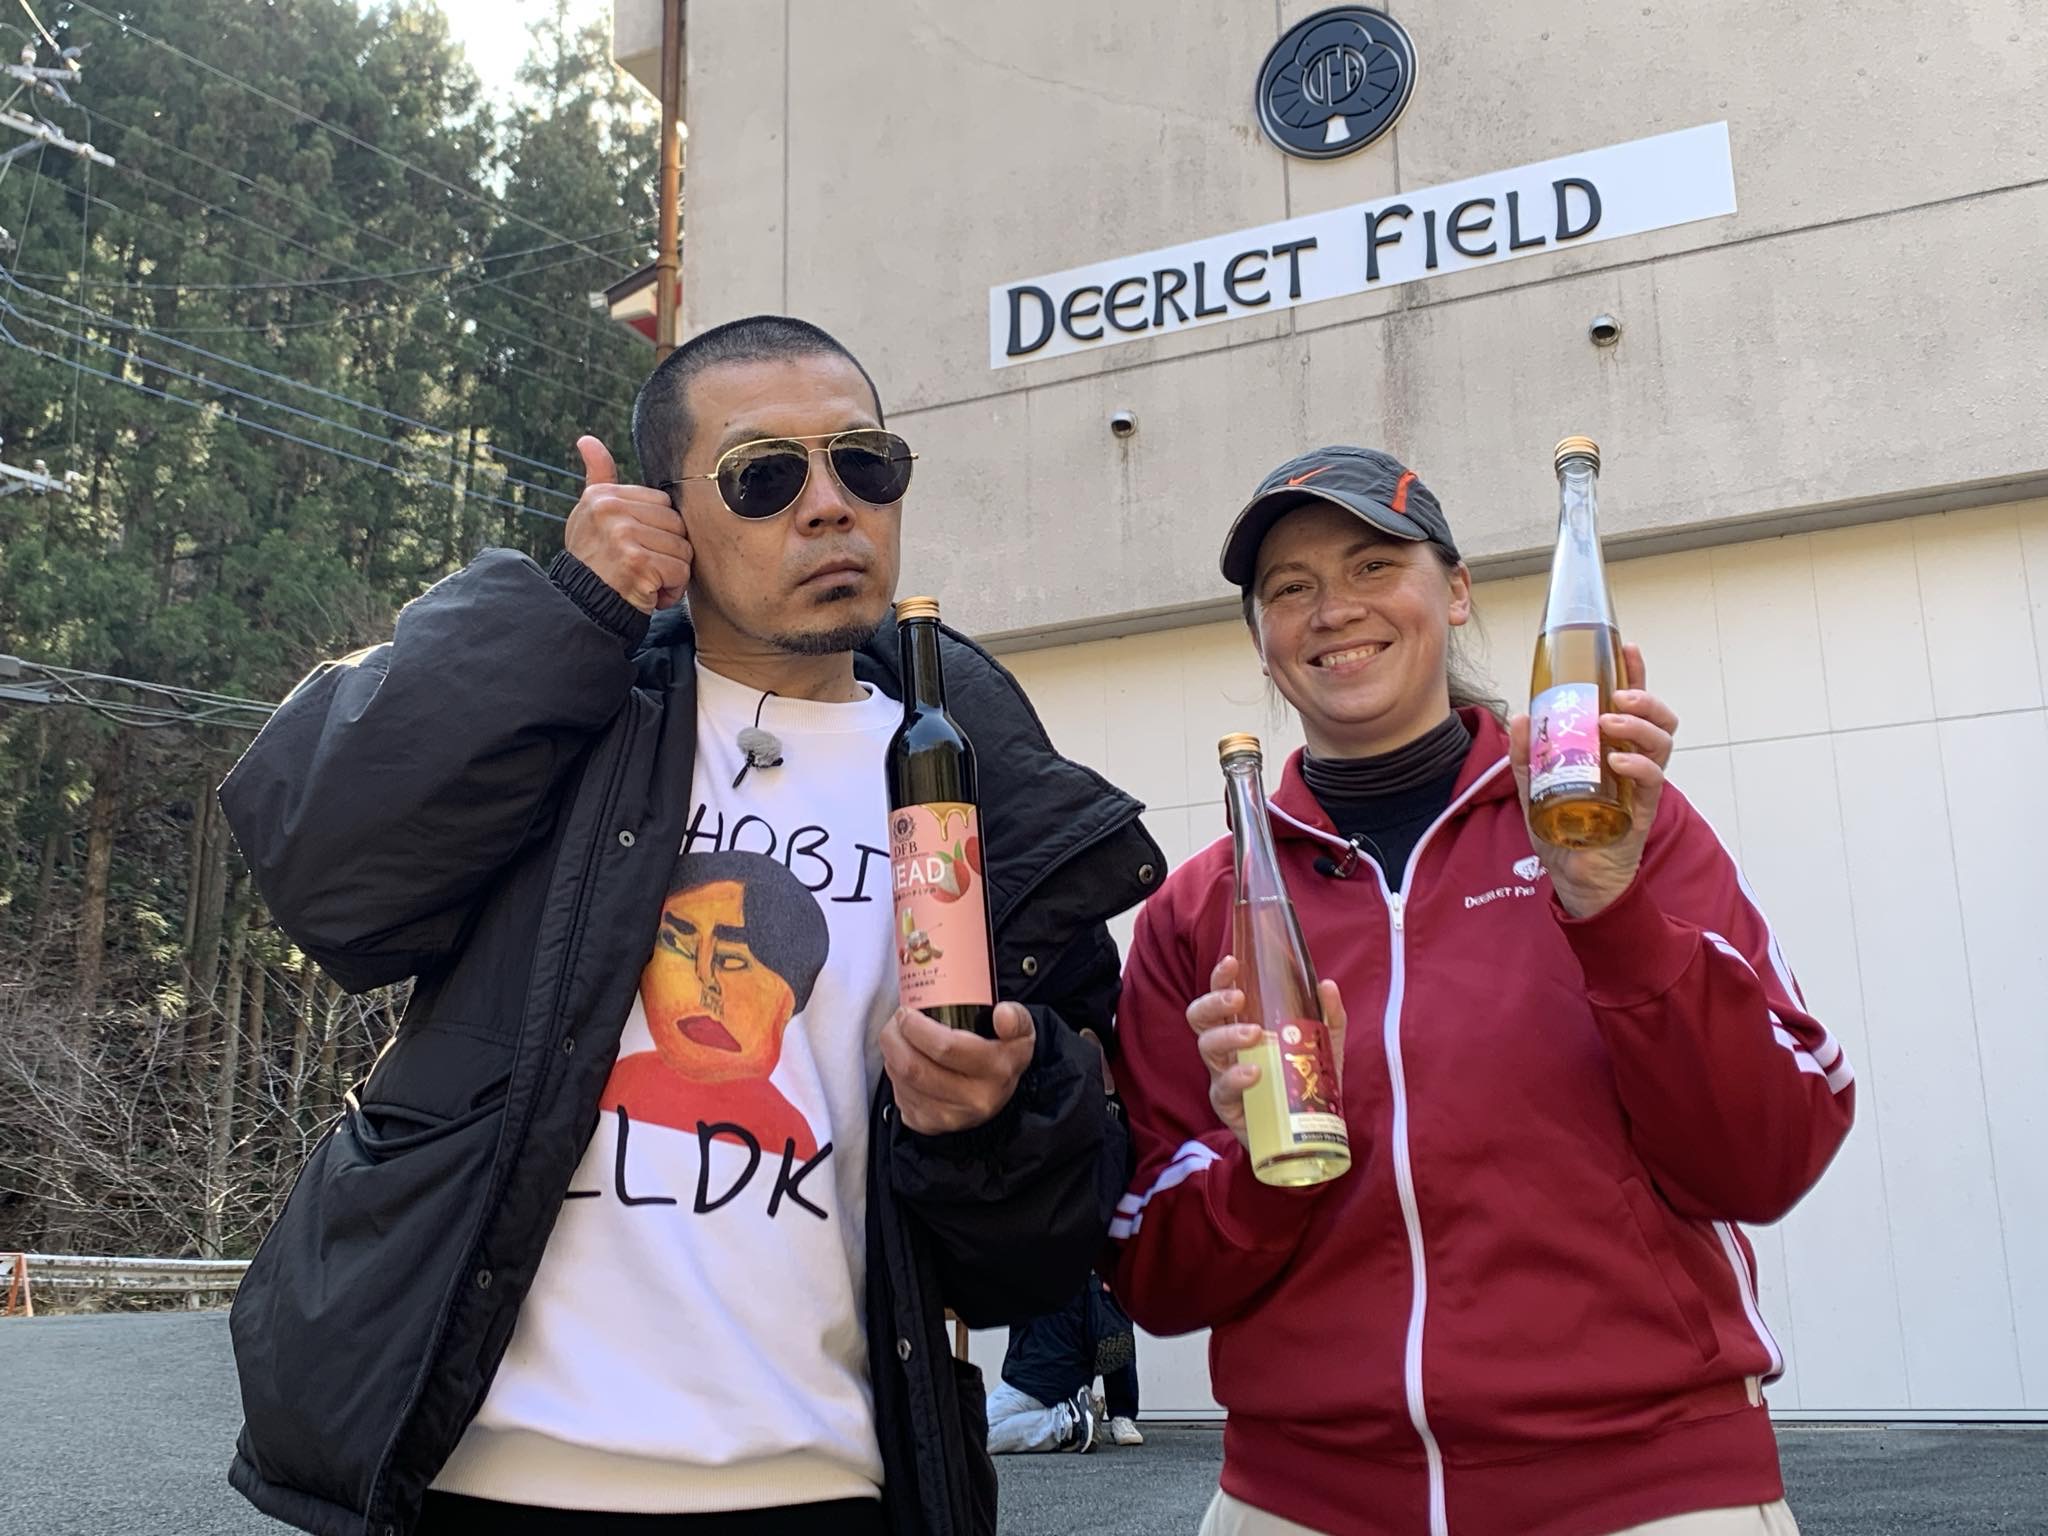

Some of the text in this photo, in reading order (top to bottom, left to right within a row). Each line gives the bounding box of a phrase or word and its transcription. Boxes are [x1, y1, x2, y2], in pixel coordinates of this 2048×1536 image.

[1004, 177, 1603, 359] DEERLET FIELD
[893, 856, 946, 892] EAD
[894, 841, 918, 858] DFB
[564, 1104, 834, 1220] LDK
